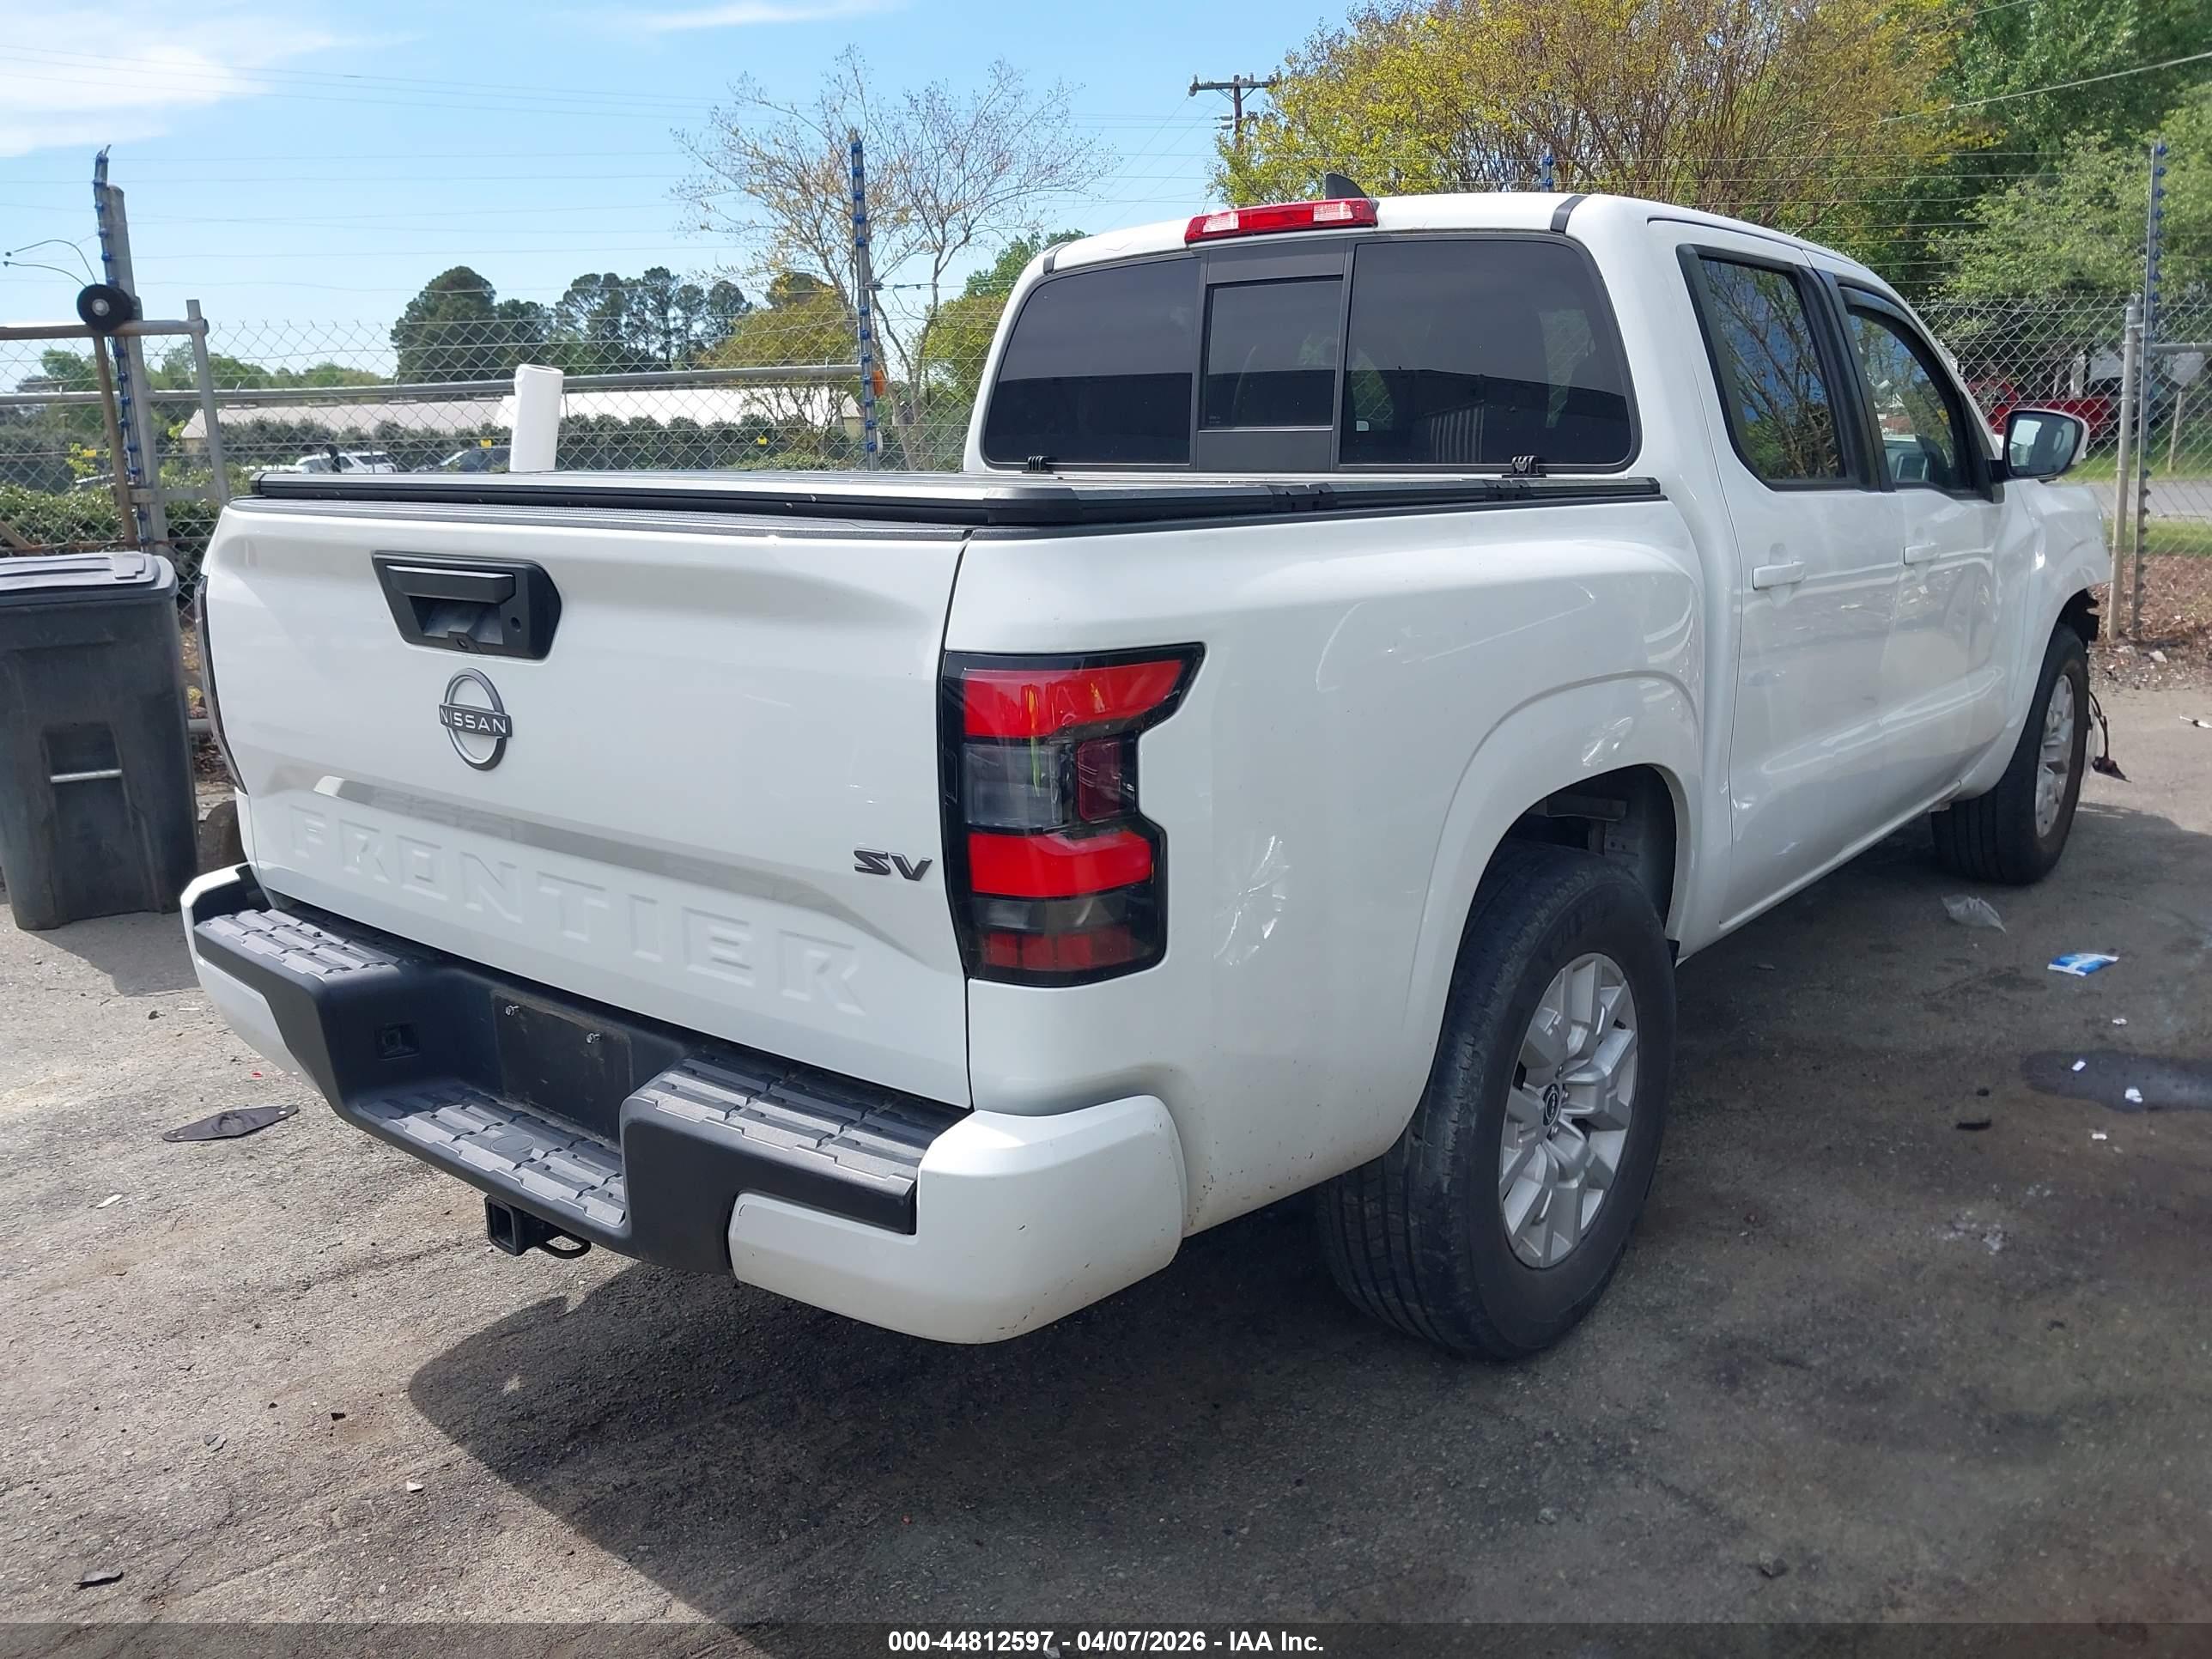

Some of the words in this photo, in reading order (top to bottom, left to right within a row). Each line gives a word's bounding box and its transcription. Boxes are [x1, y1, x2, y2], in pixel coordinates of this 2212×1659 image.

[439, 707, 507, 734] NISSAN
[854, 847, 933, 882] SV
[288, 805, 866, 1016] FRONTIER
